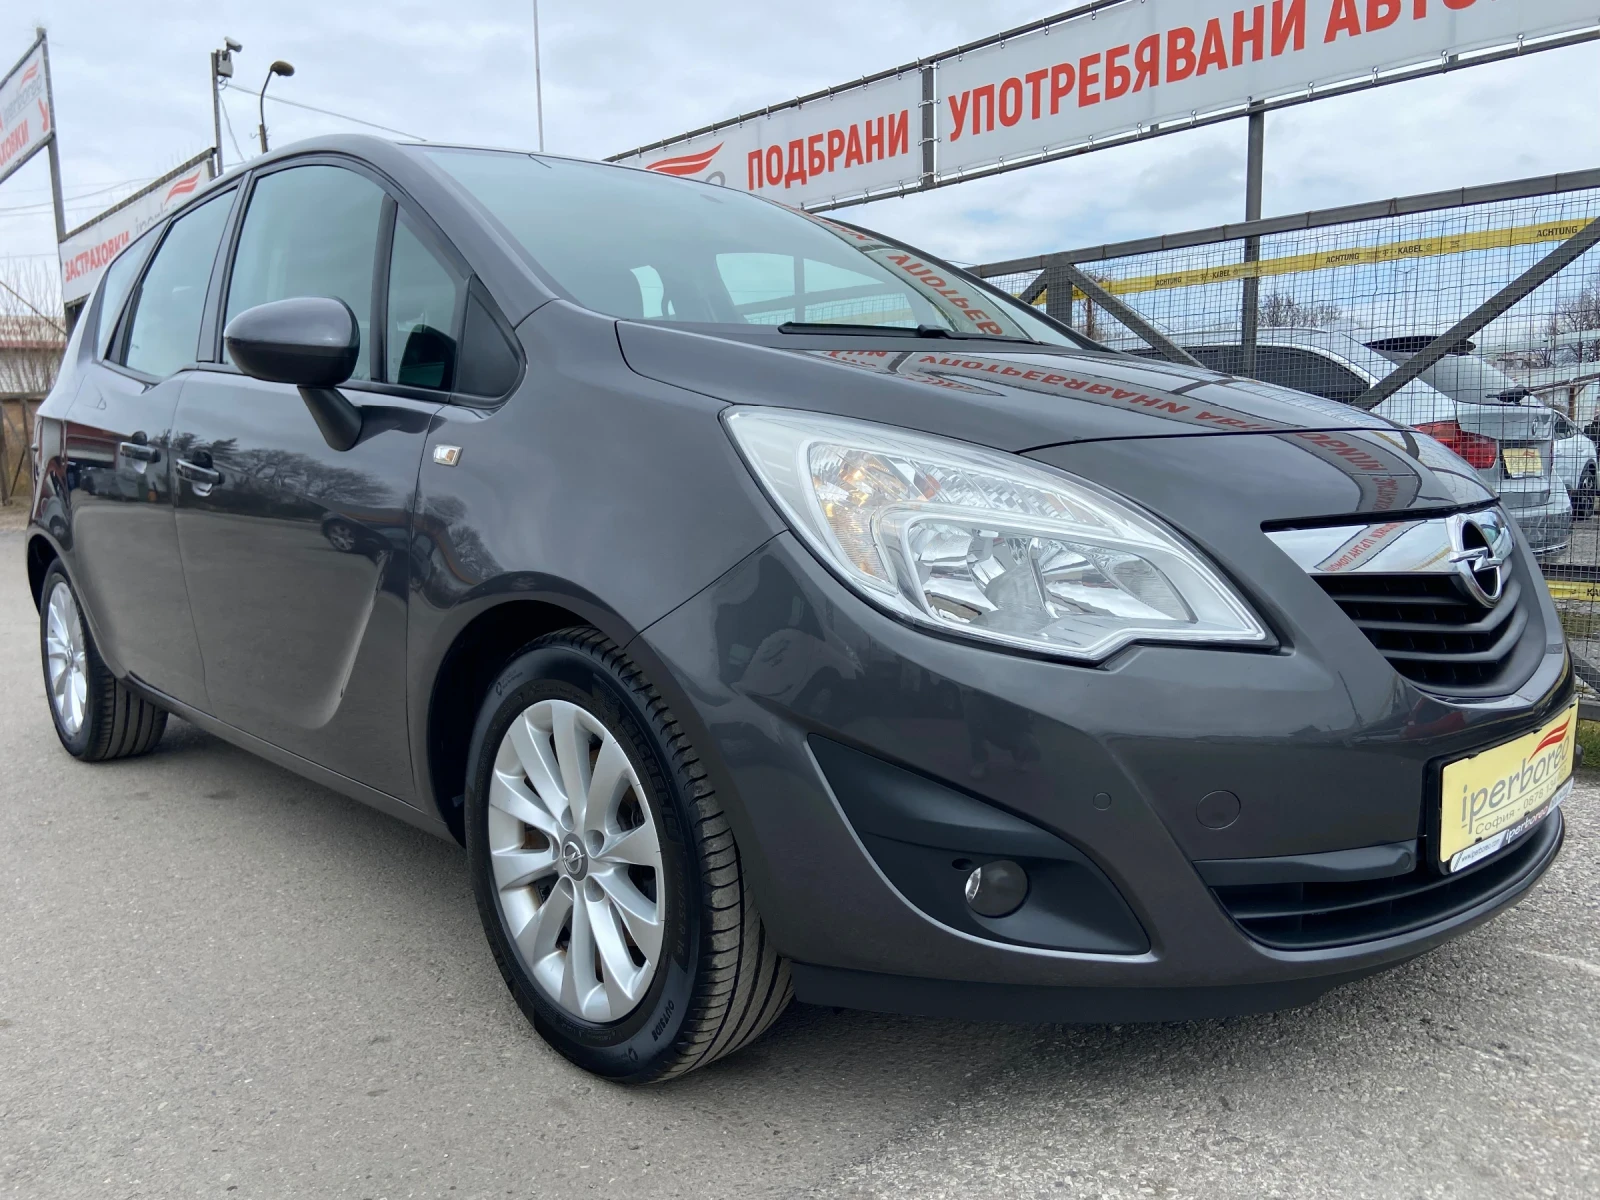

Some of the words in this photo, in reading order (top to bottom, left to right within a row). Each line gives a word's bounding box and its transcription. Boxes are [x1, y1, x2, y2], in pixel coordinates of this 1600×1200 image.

[747, 109, 909, 191] ПОДБРАНИ
[948, 0, 1306, 142] УПОТРЕБЯВАНИ
[1536, 226, 1578, 238] ACHTUNG
[1326, 252, 1360, 264] ACHTUNG
[1461, 735, 1570, 835] iperboreo
[1475, 809, 1515, 835] София
[1524, 789, 1544, 809] 0878
[651, 1000, 675, 1042] OUTSIDE
